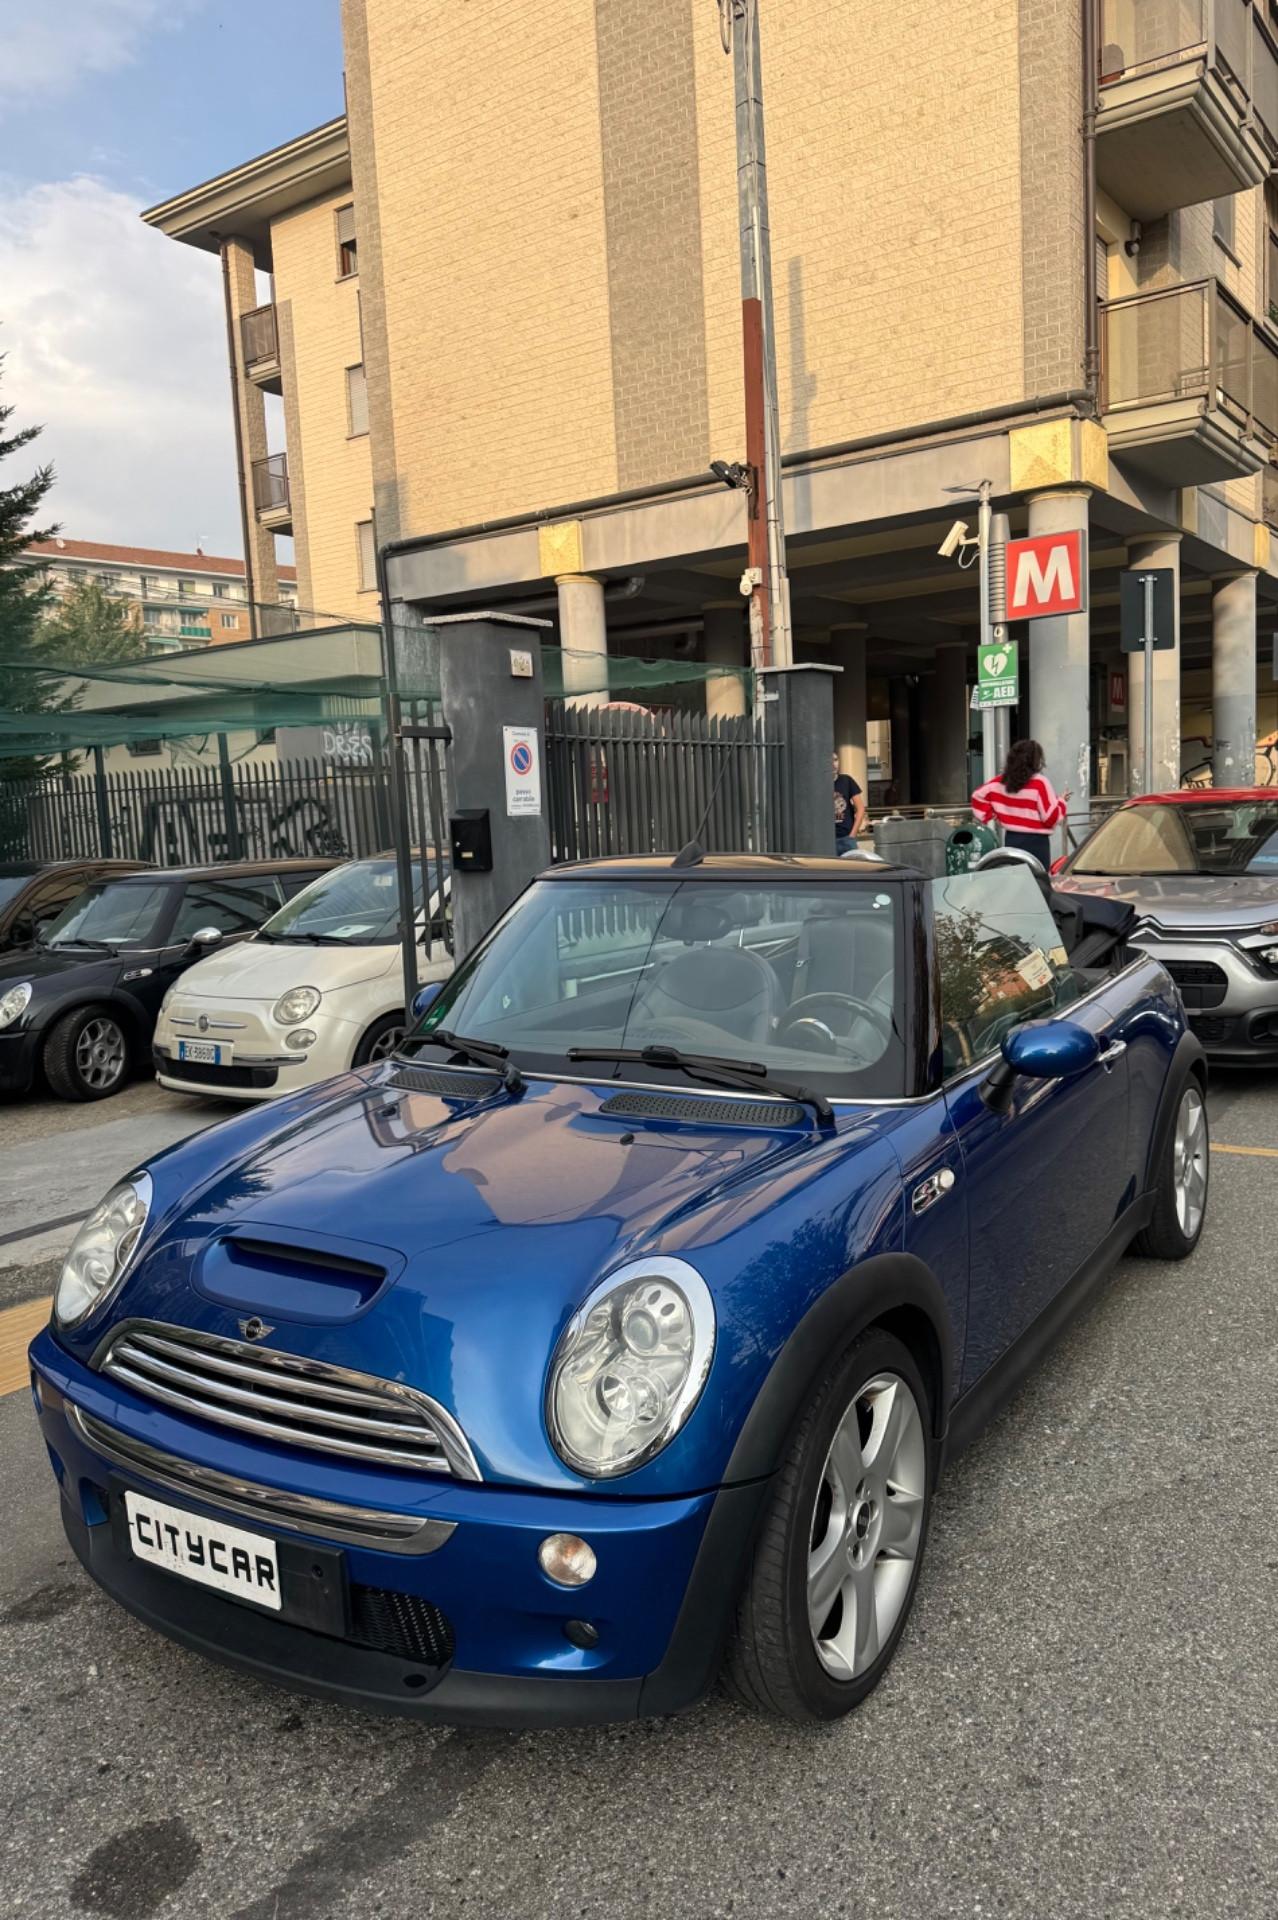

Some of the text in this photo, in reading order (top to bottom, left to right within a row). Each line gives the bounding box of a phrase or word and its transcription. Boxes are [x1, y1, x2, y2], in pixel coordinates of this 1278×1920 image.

[1013, 545, 1075, 608] M
[993, 685, 1015, 699] AED
[135, 1513, 276, 1592] CITYCAR
